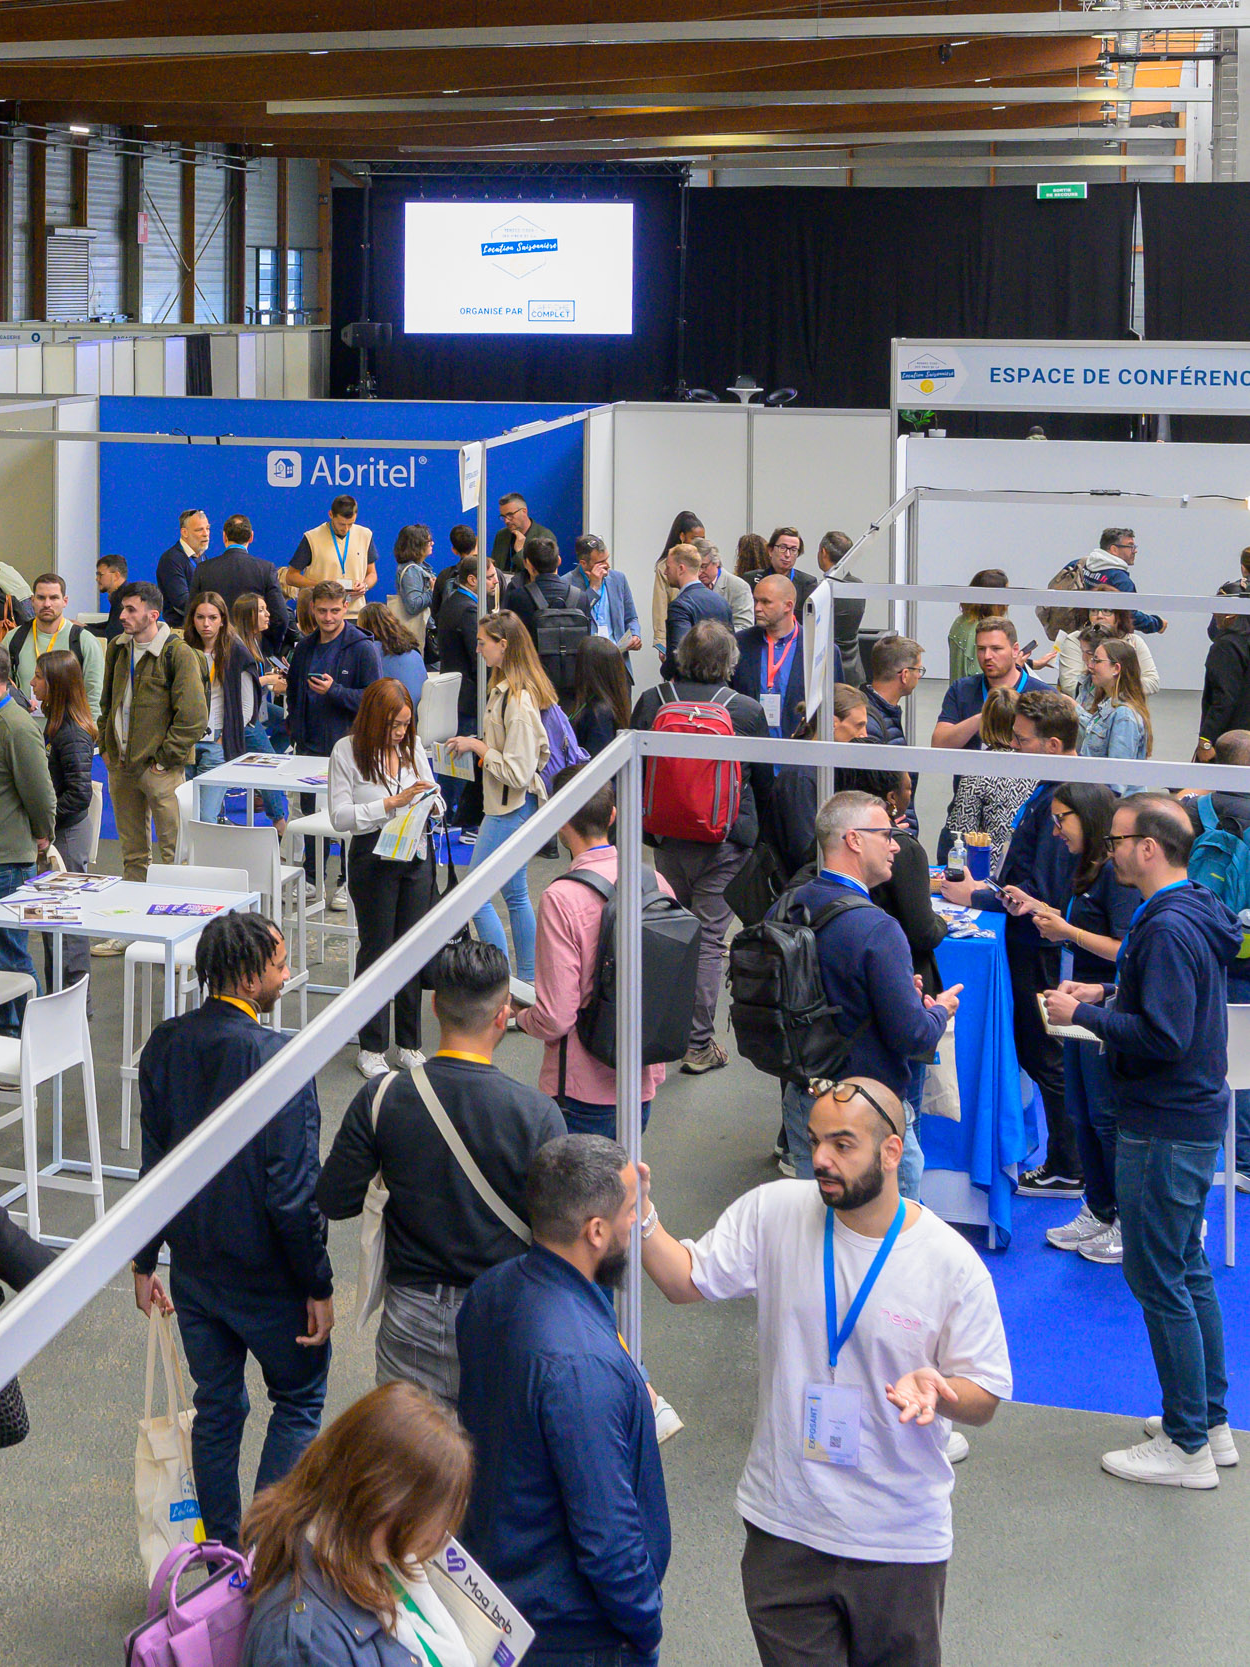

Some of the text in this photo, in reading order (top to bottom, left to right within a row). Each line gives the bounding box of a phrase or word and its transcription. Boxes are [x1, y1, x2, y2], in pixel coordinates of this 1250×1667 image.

[460, 306, 523, 315] ORGANISÉ PAR
[990, 367, 1075, 384] ESPACE
[1083, 368, 1110, 384] DE
[808, 1407, 818, 1450] EXPOSANT
